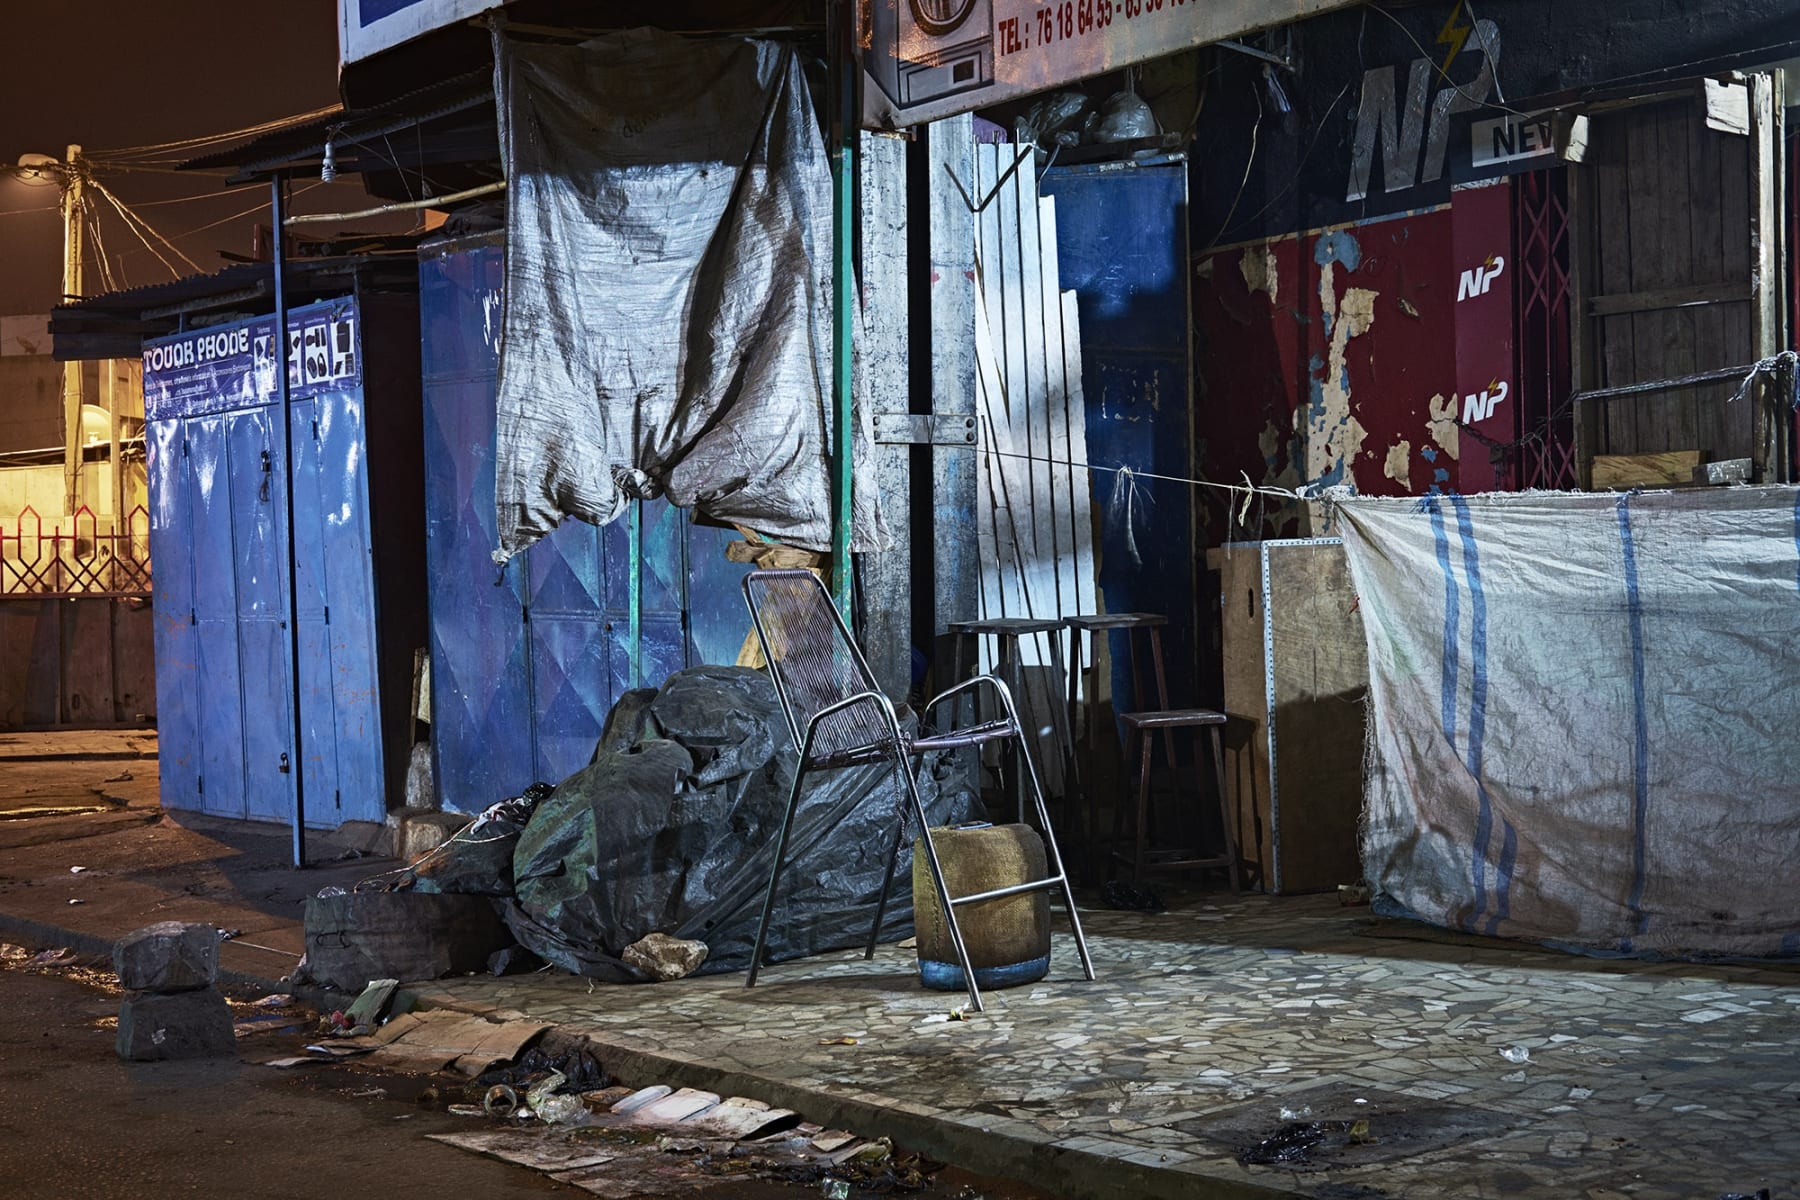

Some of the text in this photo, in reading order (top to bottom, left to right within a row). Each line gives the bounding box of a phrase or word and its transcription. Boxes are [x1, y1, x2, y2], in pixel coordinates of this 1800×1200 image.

[999, 17, 1022, 56] TEL
[1037, 7, 1052, 46] 76
[1057, 1, 1073, 40] 18
[1078, 0, 1093, 35] 64
[1346, 18, 1501, 202] NP
[1457, 256, 1505, 302] NP
[197, 328, 249, 362] PHONE
[1462, 381, 1509, 425] NP
